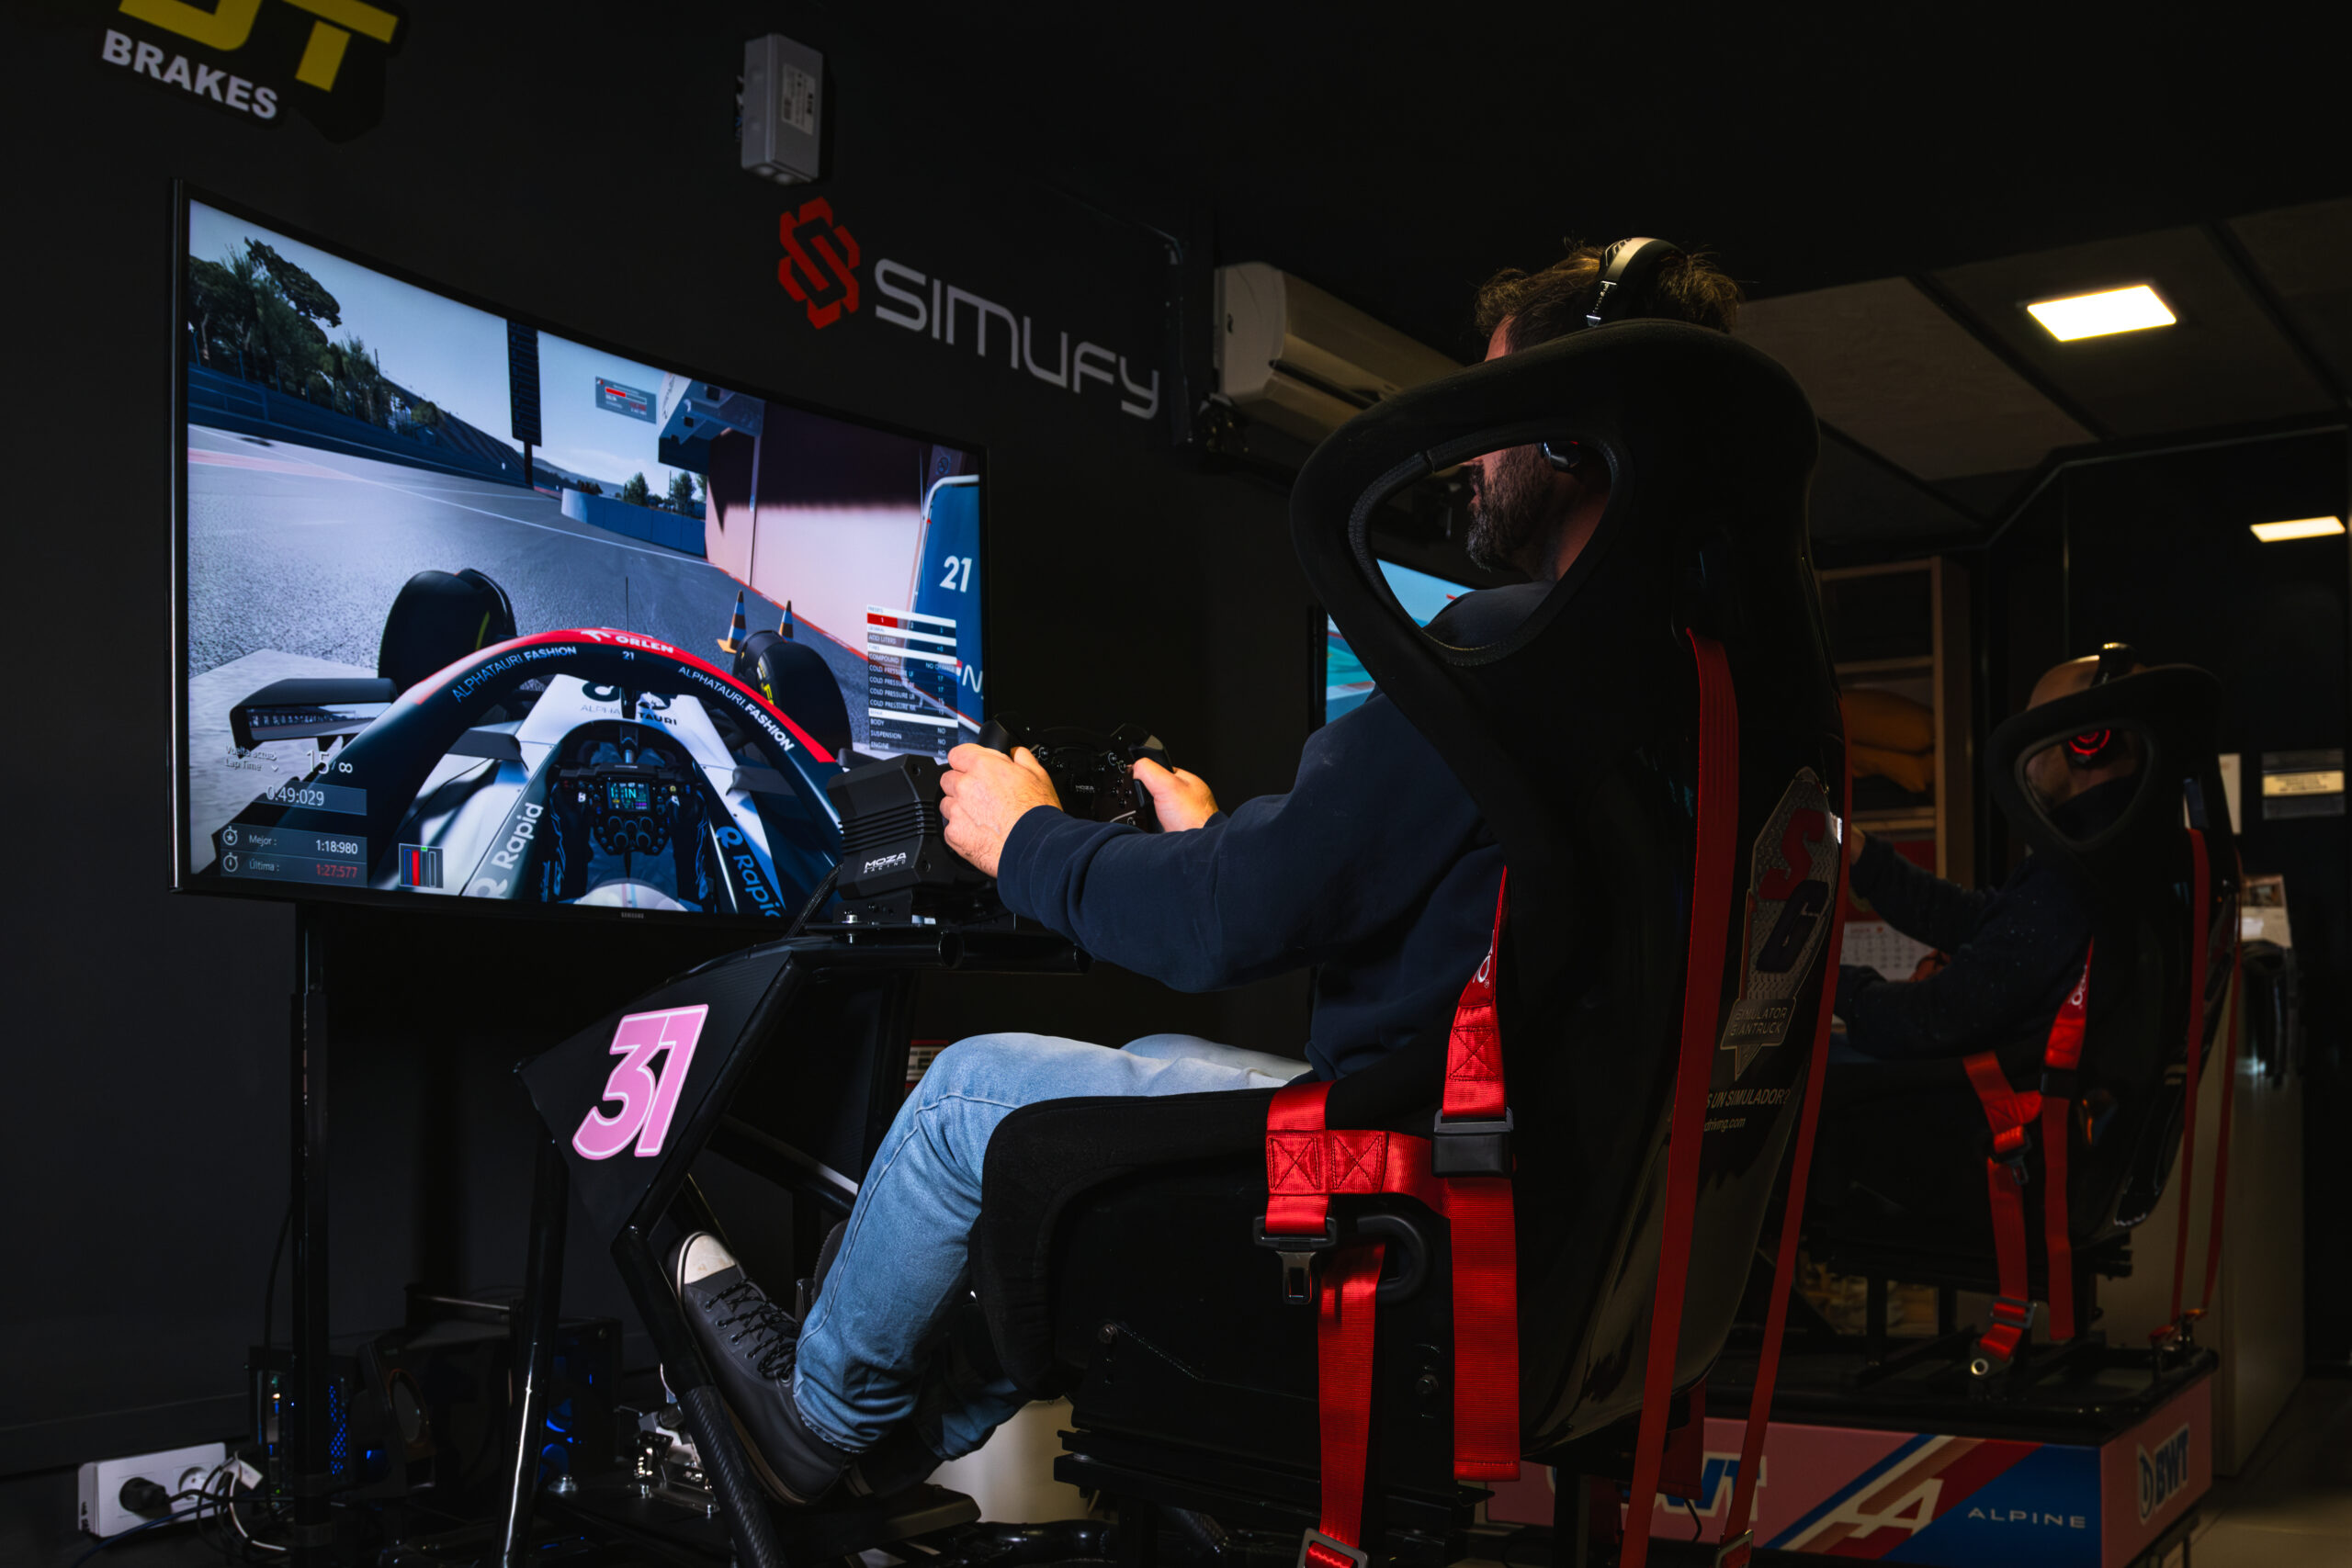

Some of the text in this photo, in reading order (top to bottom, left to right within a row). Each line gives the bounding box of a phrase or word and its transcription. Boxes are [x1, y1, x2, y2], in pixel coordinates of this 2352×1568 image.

[102, 28, 278, 120] BRAKES
[874, 258, 1160, 420] SIMUFY
[939, 555, 973, 592] 21
[616, 636, 673, 653] ORLEN
[622, 650, 635, 660] 21
[639, 713, 677, 726] TAURI
[316, 839, 358, 855] 1:18:980
[491, 802, 544, 870] Rapid
[865, 852, 907, 869] MOZA
[572, 1004, 708, 1160] 31
[1967, 1506, 2086, 1529] ALPINE
